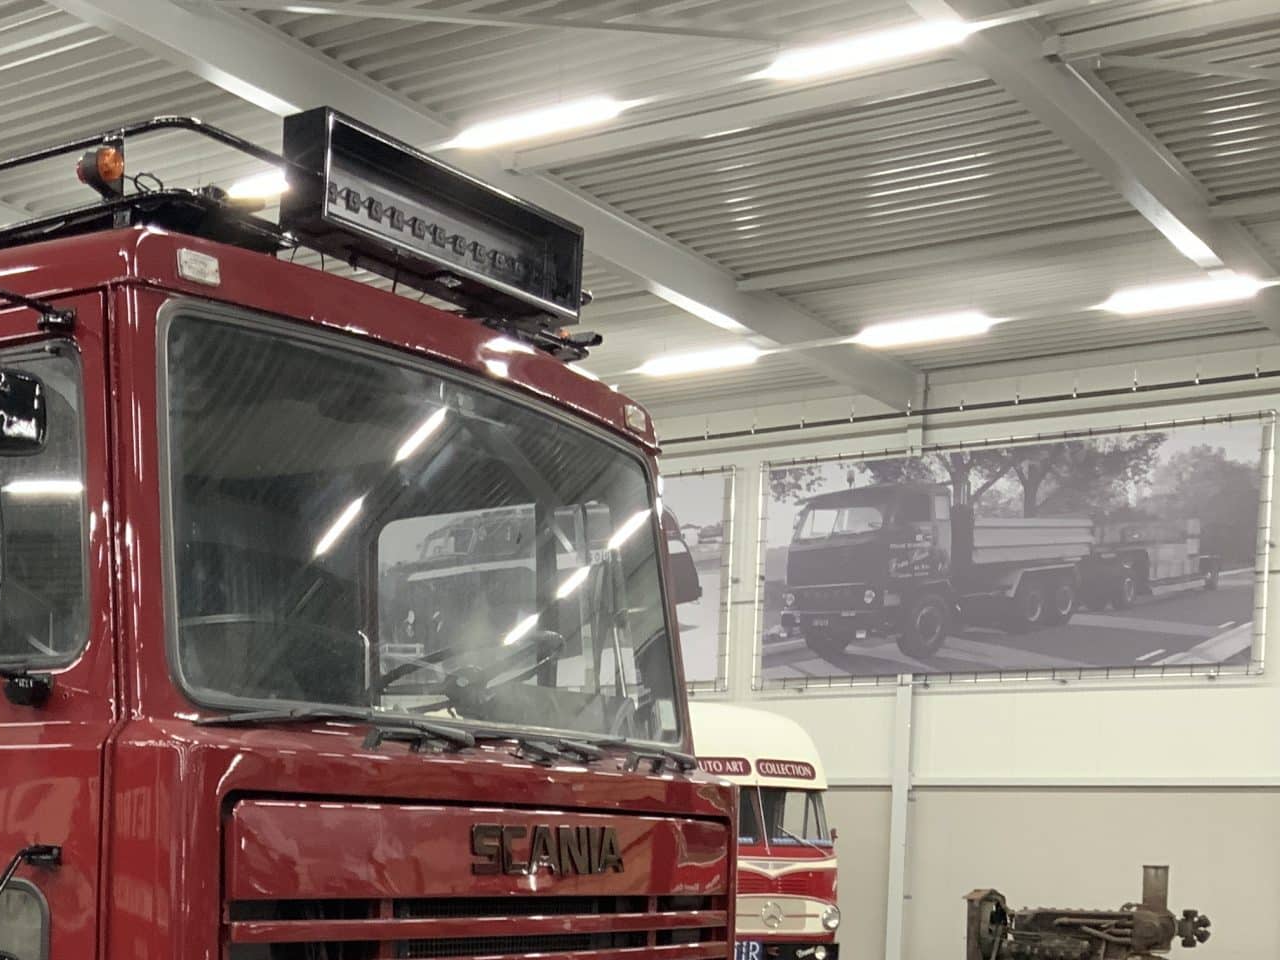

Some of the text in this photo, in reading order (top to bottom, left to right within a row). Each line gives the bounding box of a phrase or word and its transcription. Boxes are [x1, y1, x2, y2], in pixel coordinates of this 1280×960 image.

[697, 760, 812, 777] UTO ART COLLECTION
[471, 824, 624, 876] SCANIA
